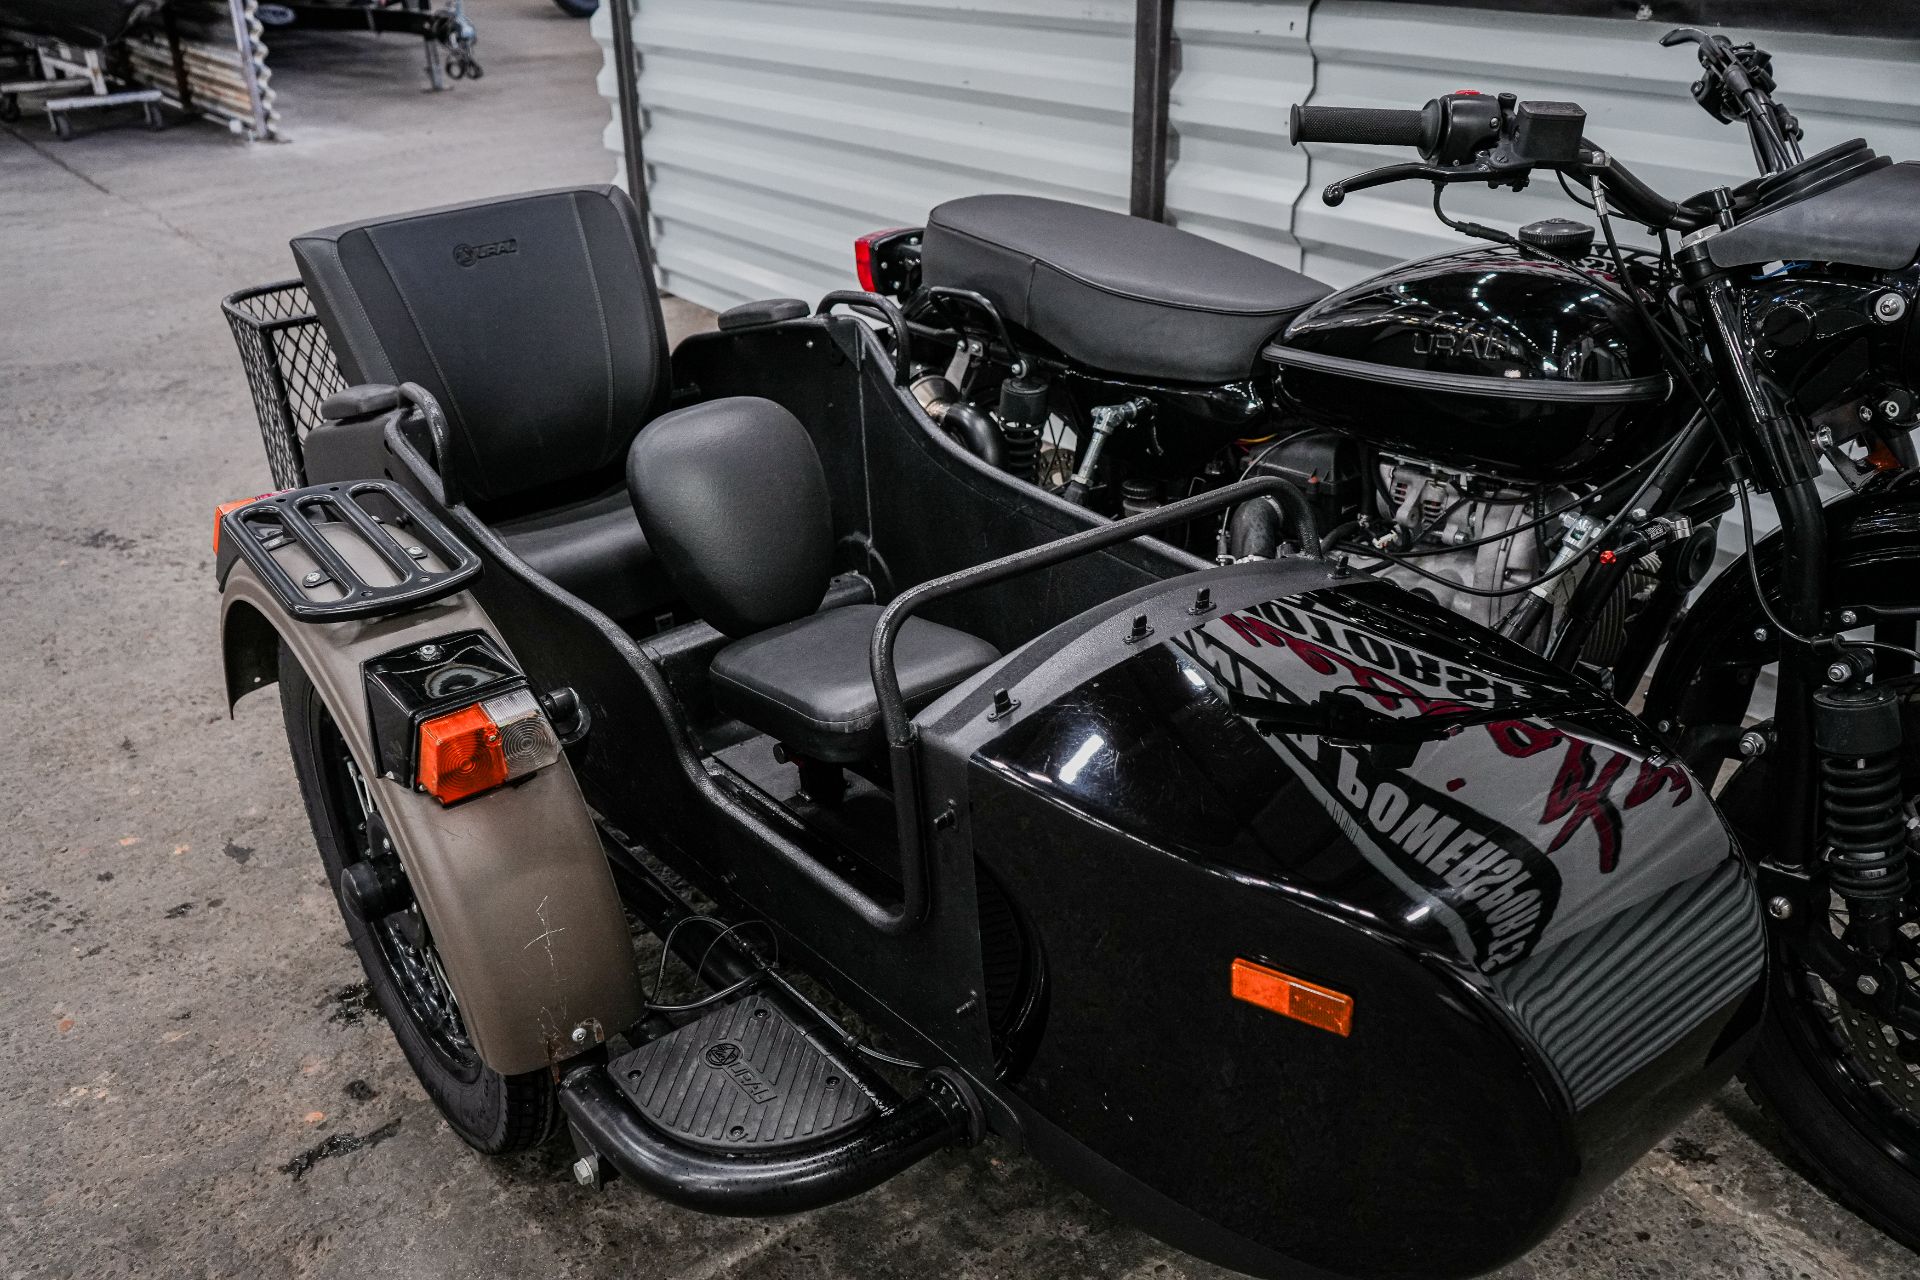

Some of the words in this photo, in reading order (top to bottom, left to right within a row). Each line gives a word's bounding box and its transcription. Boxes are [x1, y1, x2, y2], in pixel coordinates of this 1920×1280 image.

[475, 239, 517, 259] URAL
[1413, 332, 1499, 360] URAL
[727, 1062, 776, 1104] URAL
